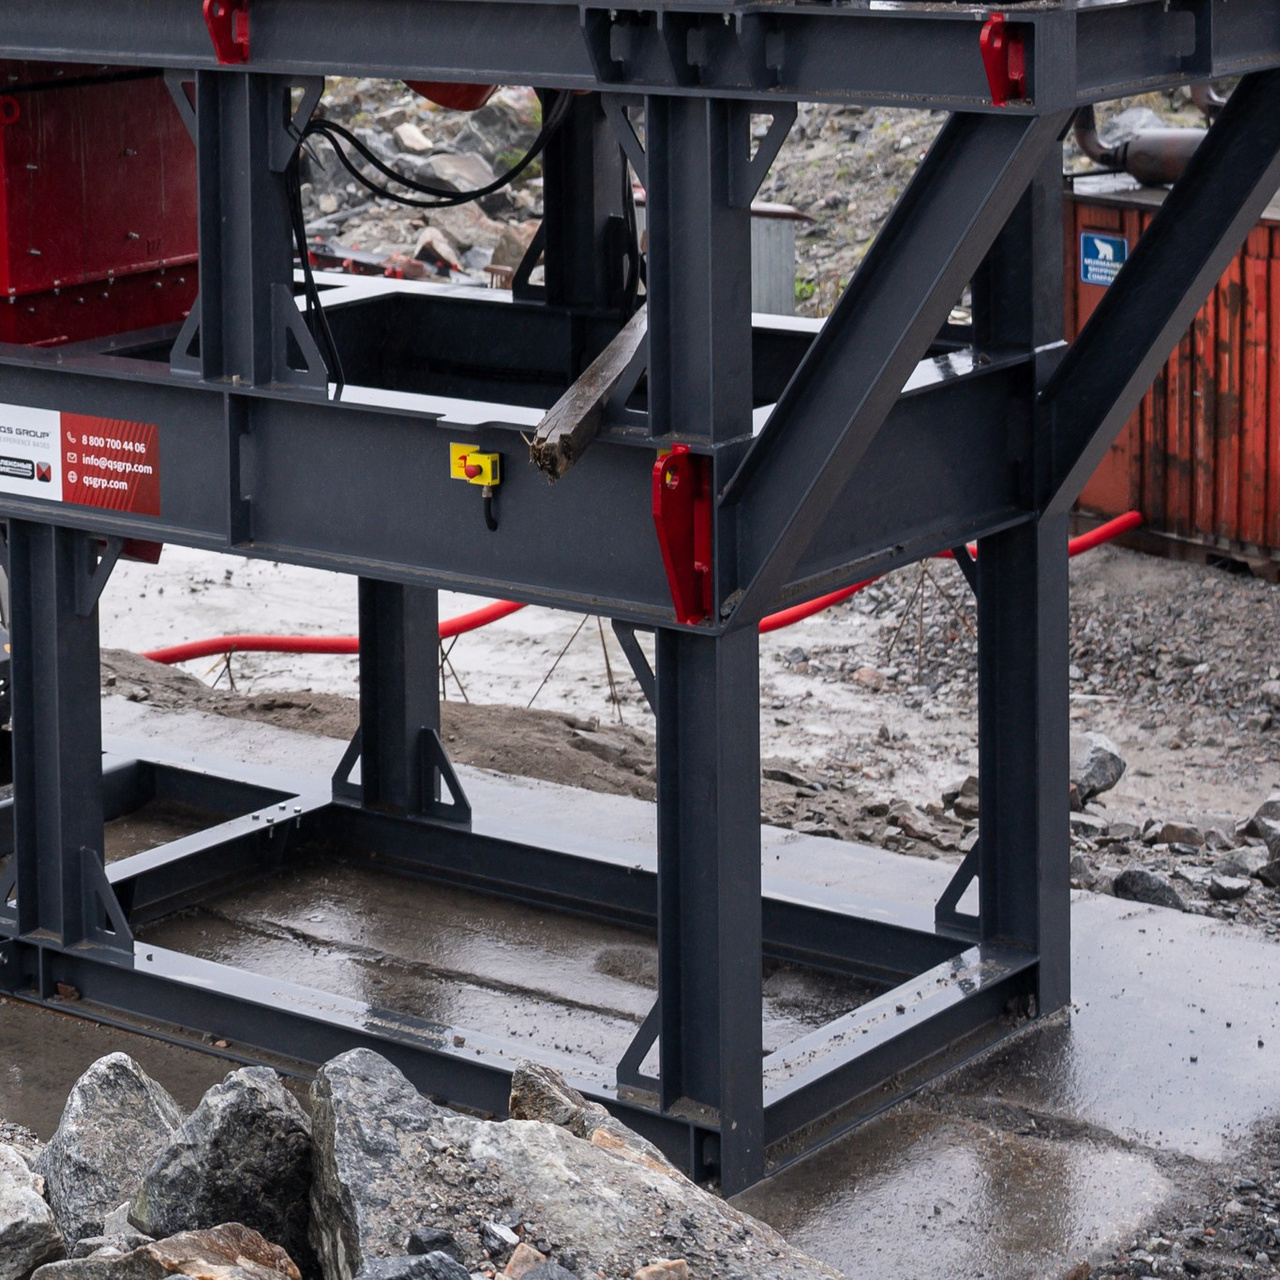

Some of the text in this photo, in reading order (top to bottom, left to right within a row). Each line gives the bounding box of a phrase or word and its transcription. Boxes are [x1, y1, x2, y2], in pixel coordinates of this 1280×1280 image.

[0, 425, 49, 439] QS GROUP
[82, 434, 146, 453] 8 800 700 44 06
[82, 453, 153, 474] info@qsgrp.com
[82, 475, 128, 490] qsgrp.com
